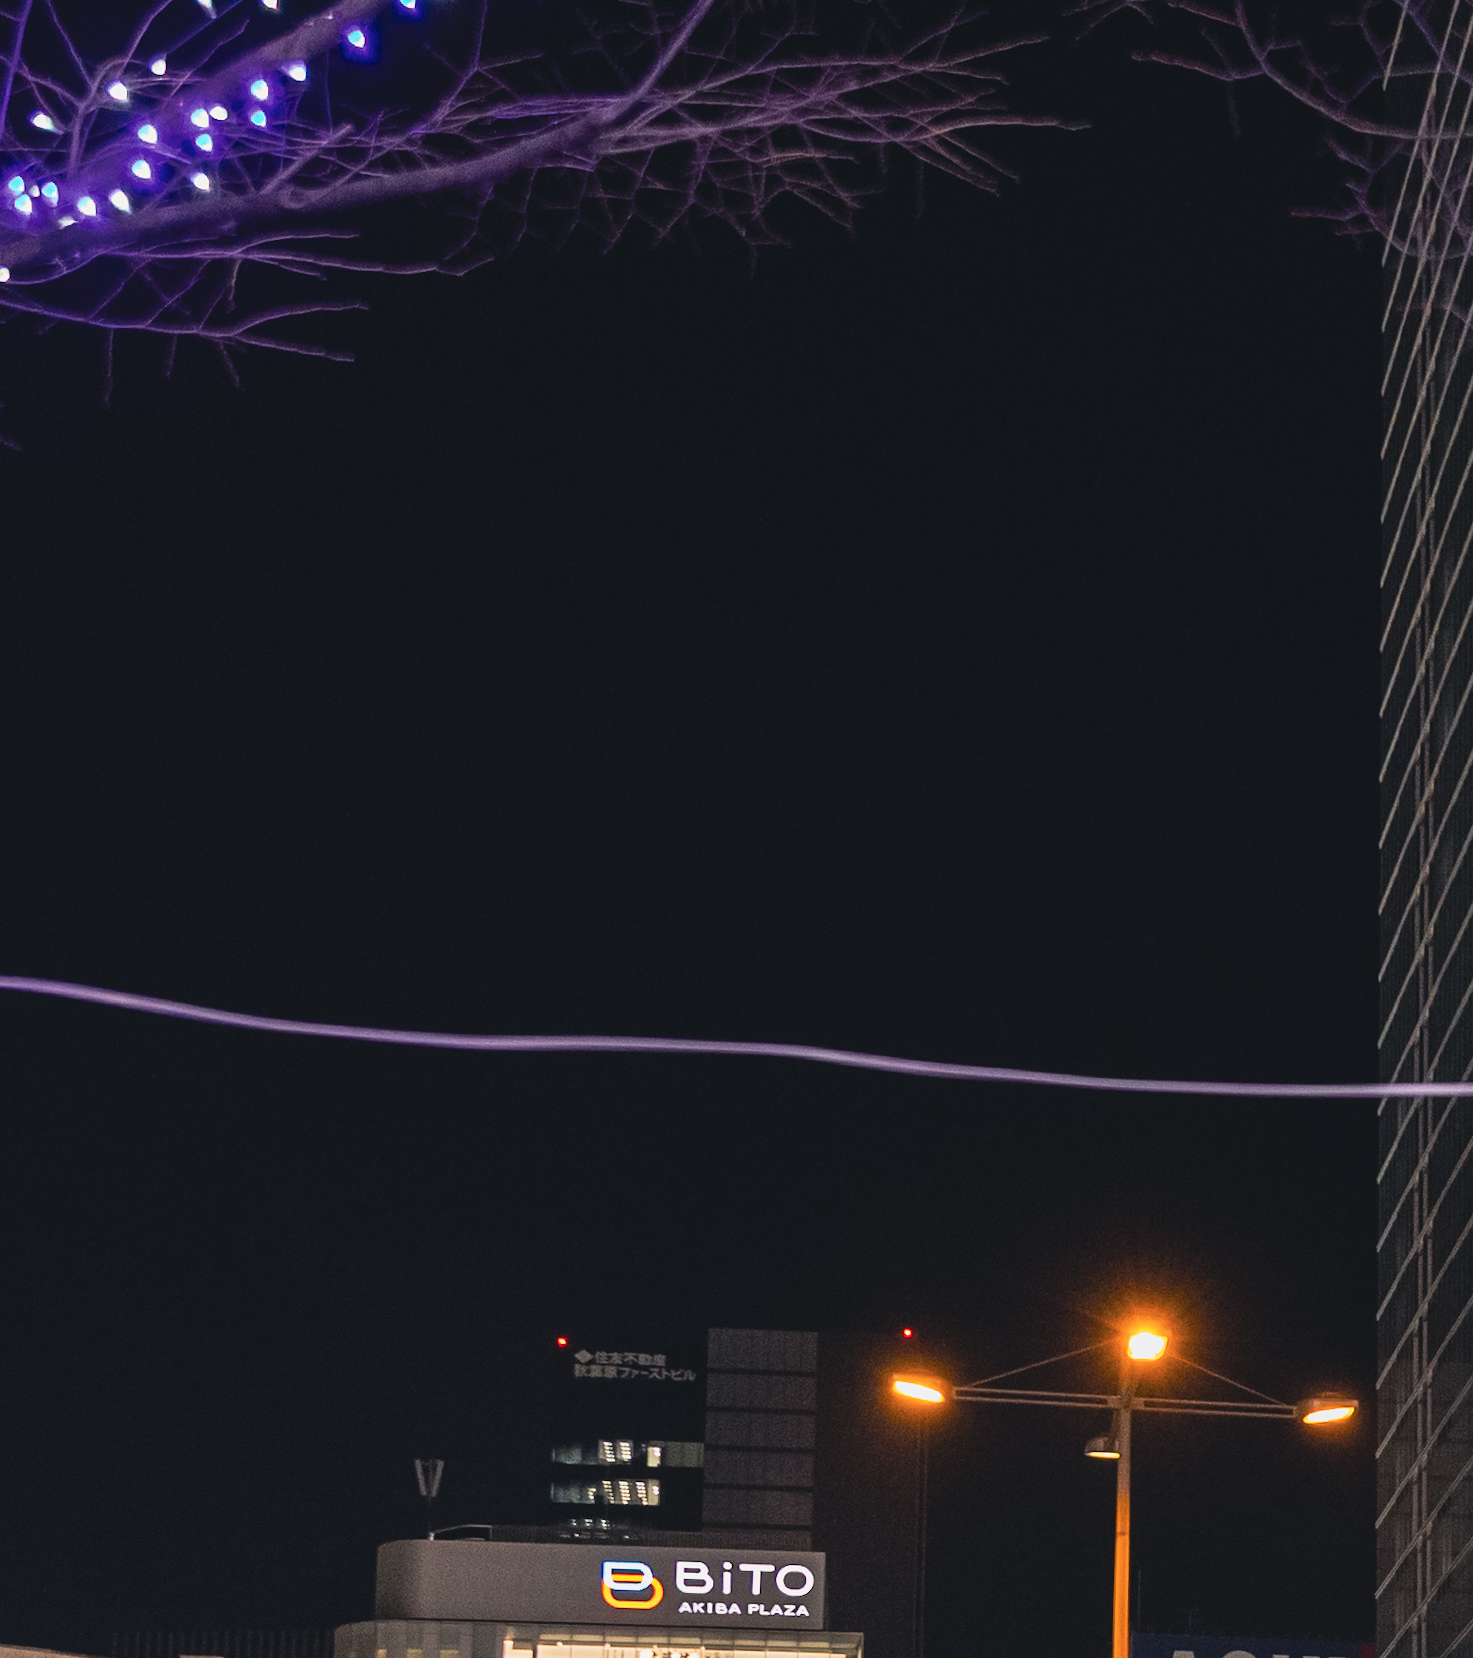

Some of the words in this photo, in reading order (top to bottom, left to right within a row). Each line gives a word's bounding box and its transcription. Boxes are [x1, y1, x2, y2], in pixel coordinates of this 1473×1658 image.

[675, 1560, 815, 1597] BiTO
[678, 1601, 742, 1616] AKIBA
[747, 1603, 810, 1617] PLAZA
